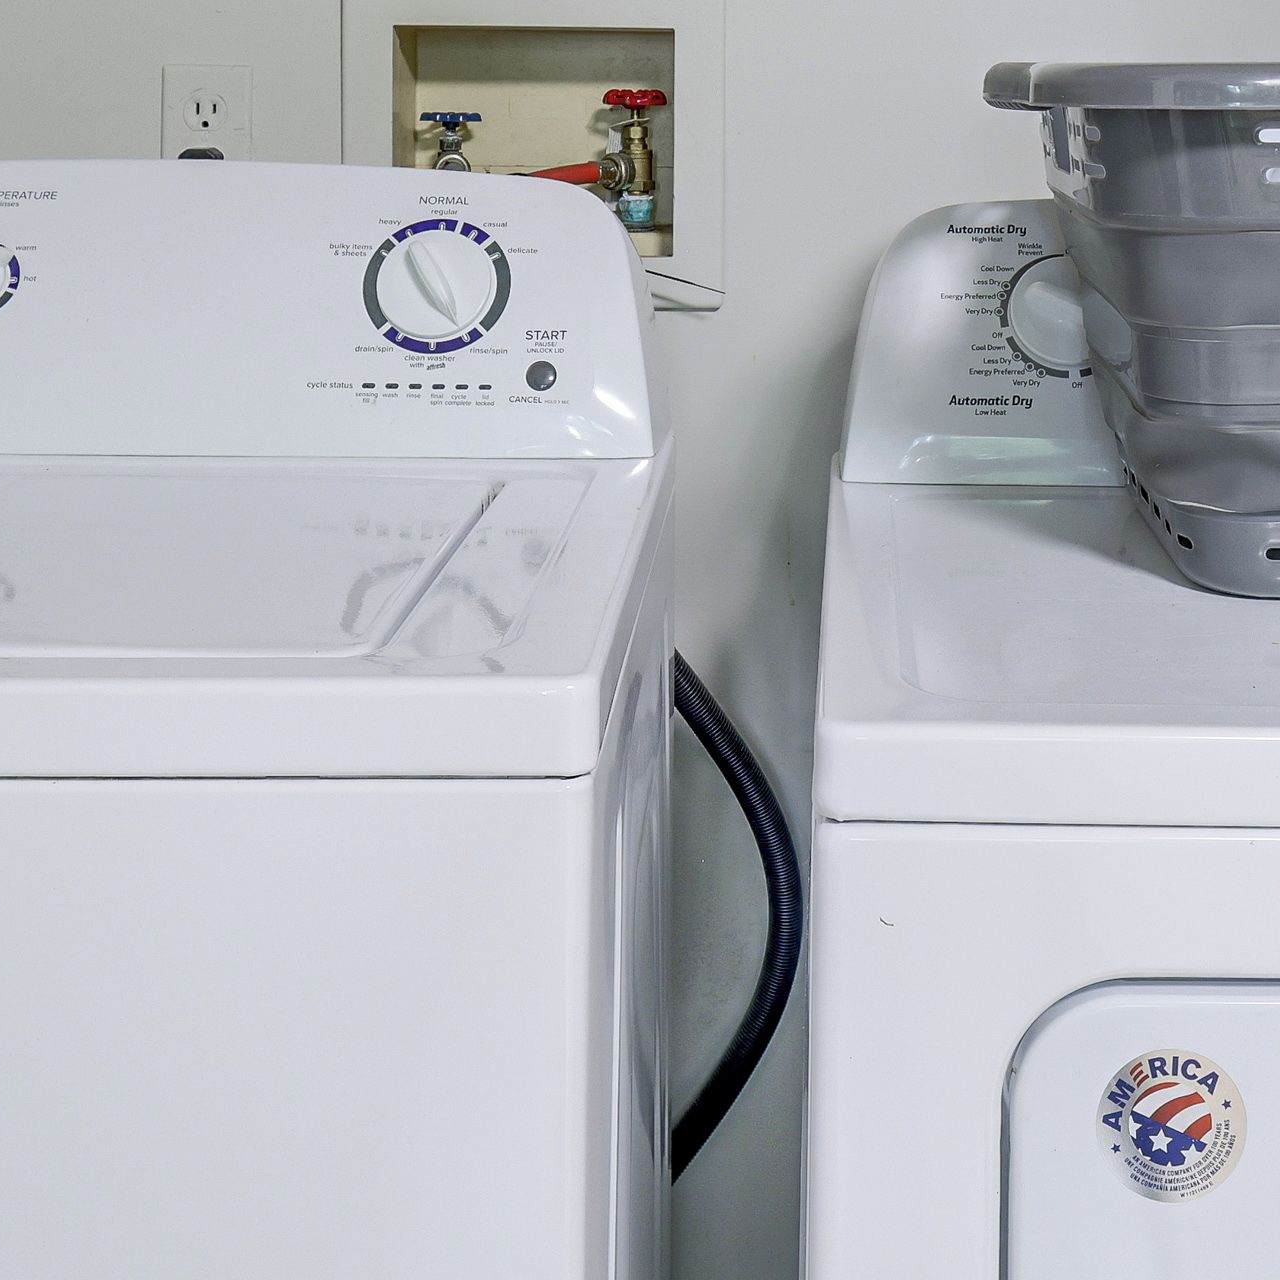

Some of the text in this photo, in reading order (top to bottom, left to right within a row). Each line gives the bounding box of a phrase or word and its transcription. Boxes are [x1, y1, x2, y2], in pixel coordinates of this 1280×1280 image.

[419, 196, 469, 205] NORMAL
[379, 218, 402, 226] heavy
[947, 224, 1027, 236] Automatic Dry
[941, 293, 963, 301] Energy
[965, 308, 993, 316] Very Dry
[525, 330, 567, 340] START
[355, 345, 394, 353] drain/spin
[470, 347, 508, 355] rinse/spin
[1000, 358, 1012, 366] Dry
[969, 368, 992, 376] Energy
[307, 381, 353, 389] cycle status
[1013, 379, 1040, 388] Very Dry
[949, 395, 1033, 409] Automatic Dry
[1102, 1056, 1219, 1133] AMERICA
[1132, 1123, 1223, 1176] AN AMERICAN COMPANY FOR OVER 100 YEARS
[1124, 1157, 1135, 1168] UNE
[1133, 1166, 1164, 1183] COMPAGNIE
[1197, 1161, 1214, 1177] DEPUIS
[1212, 1149, 1224, 1163] PLUS
[1220, 1141, 1227, 1149] DE
[1130, 1173, 1140, 1183] UNA
[1170, 1180, 1200, 1192] AMERICANA
[1200, 1174, 1211, 1184] POR
[1210, 1165, 1221, 1176] MÁS
[1219, 1158, 1227, 1166] DE
[1224, 1150, 1232, 1159] 100
